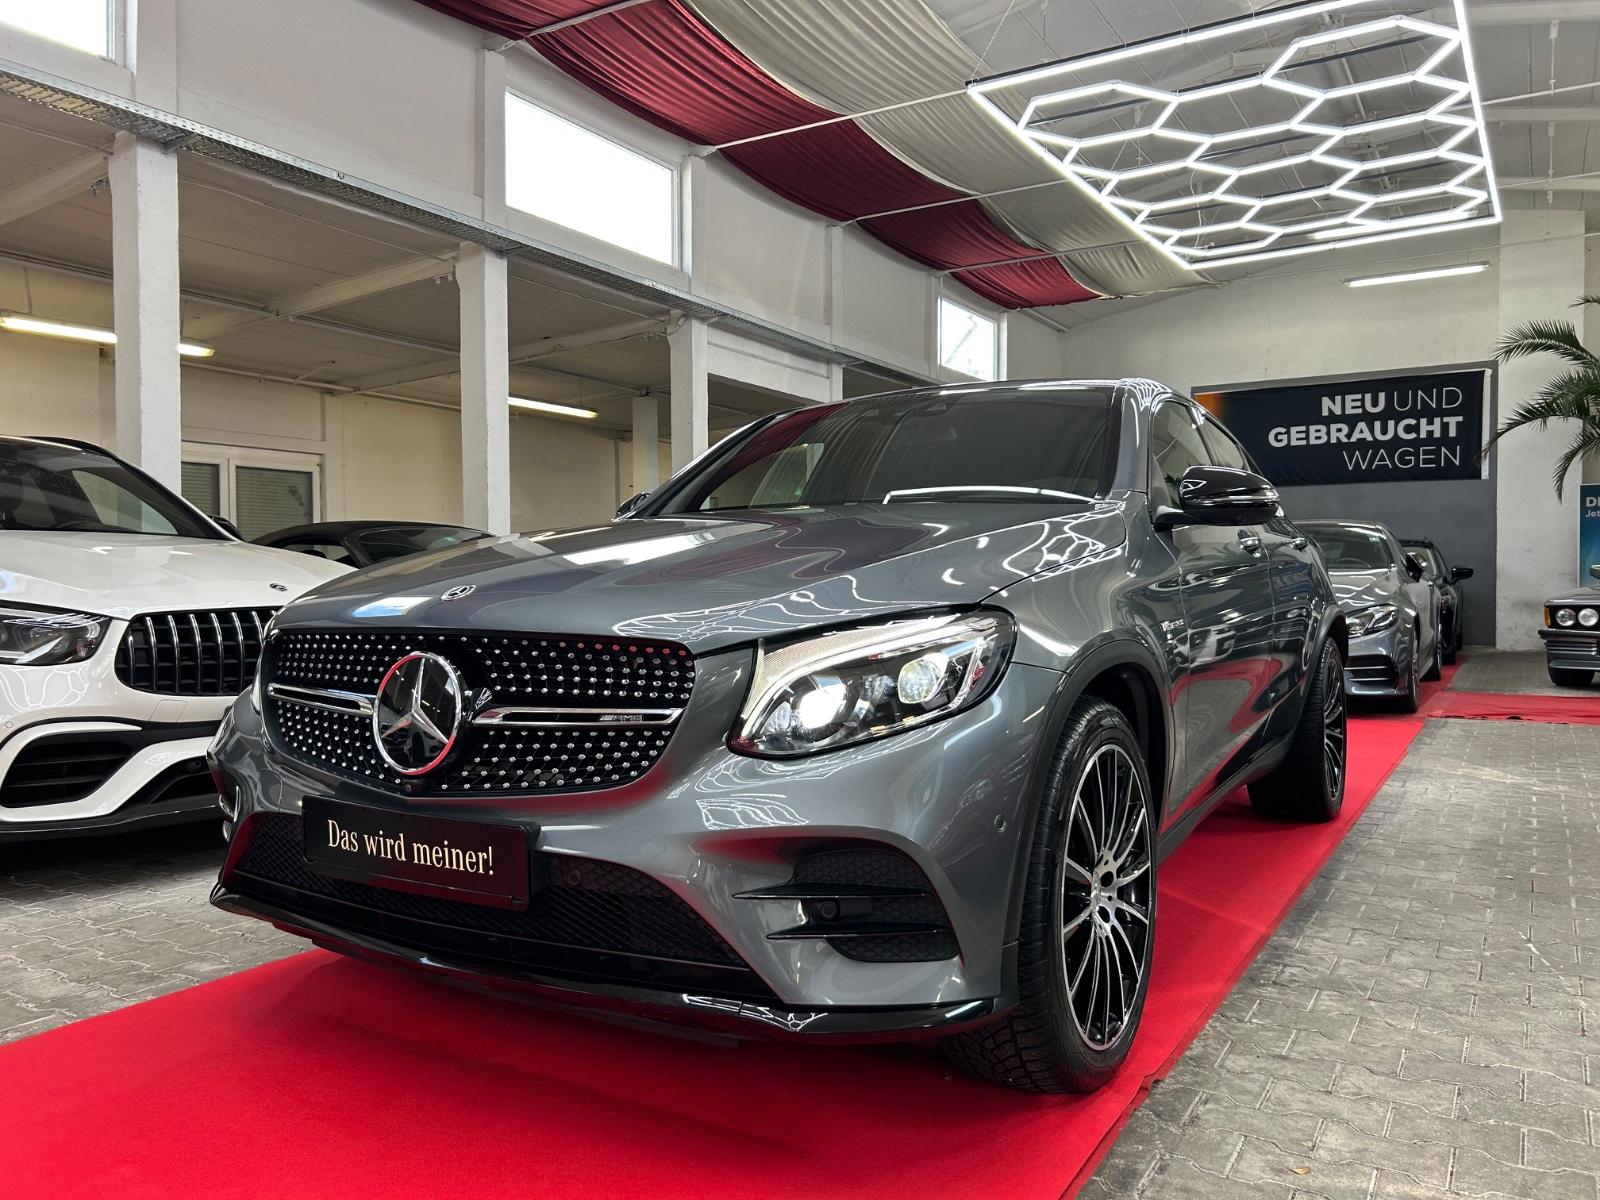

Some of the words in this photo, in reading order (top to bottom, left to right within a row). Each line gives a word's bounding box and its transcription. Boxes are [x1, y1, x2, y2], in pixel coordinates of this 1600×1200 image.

[1321, 391, 1386, 416] NEU
[1394, 387, 1463, 411] UND
[1268, 415, 1464, 448] GEBRAUCHT
[1343, 444, 1460, 470] WAGEN
[327, 819, 359, 852] Das
[364, 830, 407, 861] wird
[412, 840, 495, 876] meiner!
